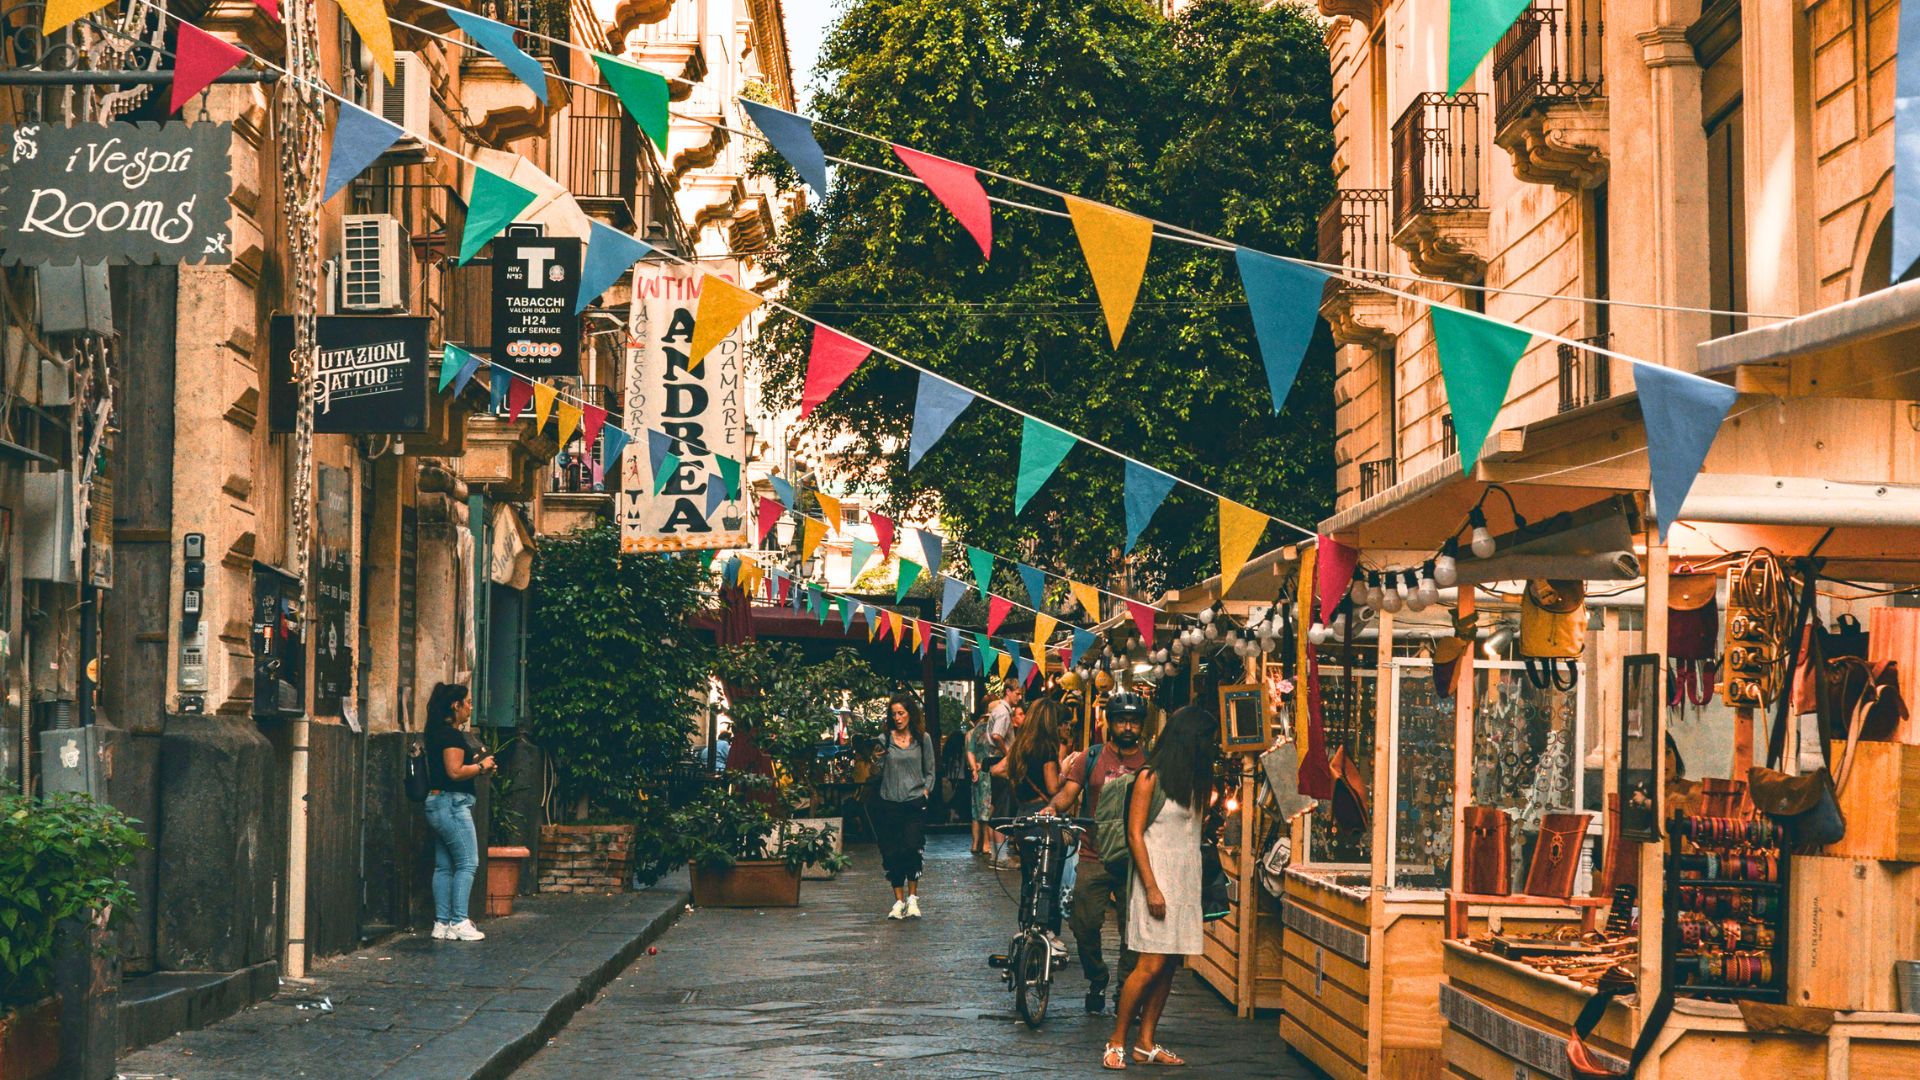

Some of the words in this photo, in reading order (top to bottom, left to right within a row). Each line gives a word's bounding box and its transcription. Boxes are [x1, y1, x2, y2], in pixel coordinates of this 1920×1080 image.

[66, 147, 81, 172] i
[87, 138, 193, 189] Vespri
[19, 188, 197, 244] Rooms
[517, 247, 555, 289] T
[506, 297, 565, 307] TABACCHI
[522, 315, 547, 326] H24
[509, 343, 560, 355] LOTTO
[313, 366, 389, 415] TATTOO
[659, 307, 713, 534] ANDREA
